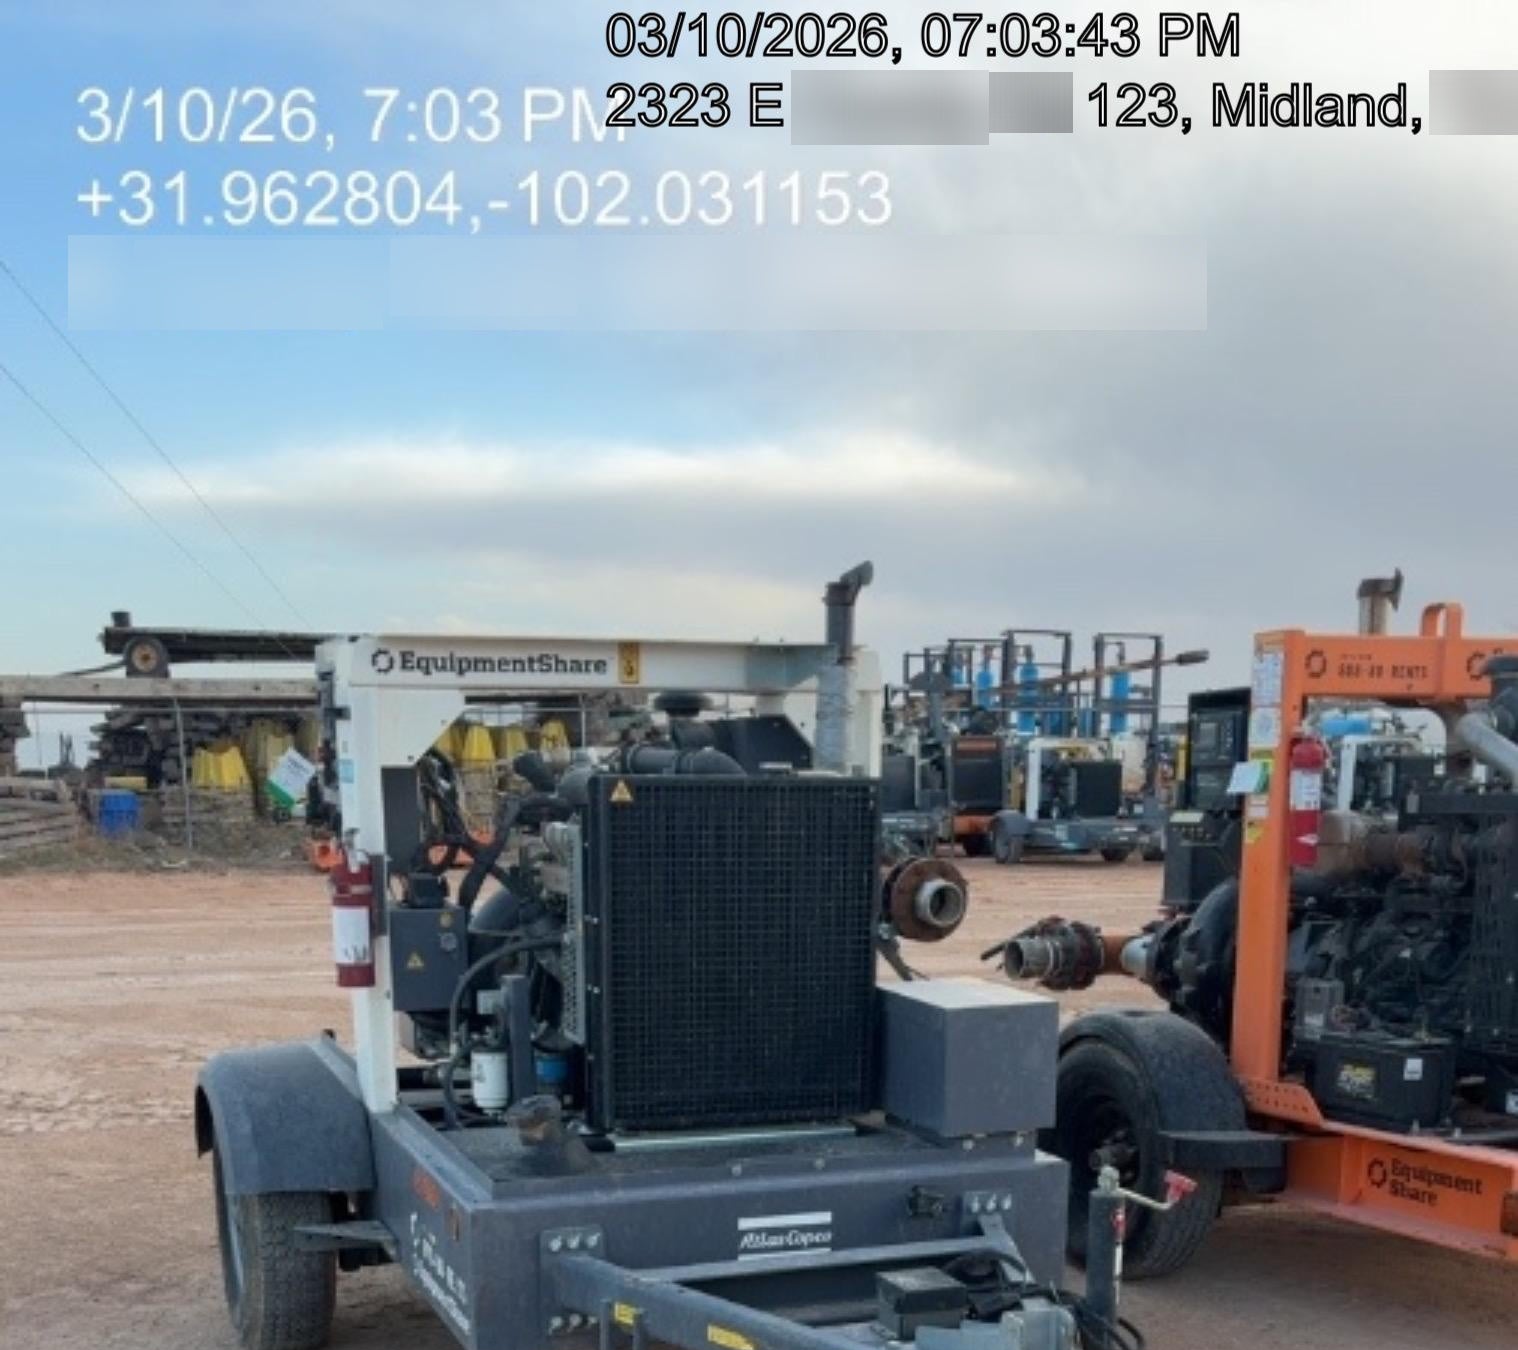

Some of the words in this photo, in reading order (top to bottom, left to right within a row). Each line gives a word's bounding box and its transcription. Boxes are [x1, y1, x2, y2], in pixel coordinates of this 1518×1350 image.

[399, 650, 608, 676] EquipmentShare
[1391, 1158, 1483, 1195] Equipment
[1389, 1179, 1438, 1206] Share
